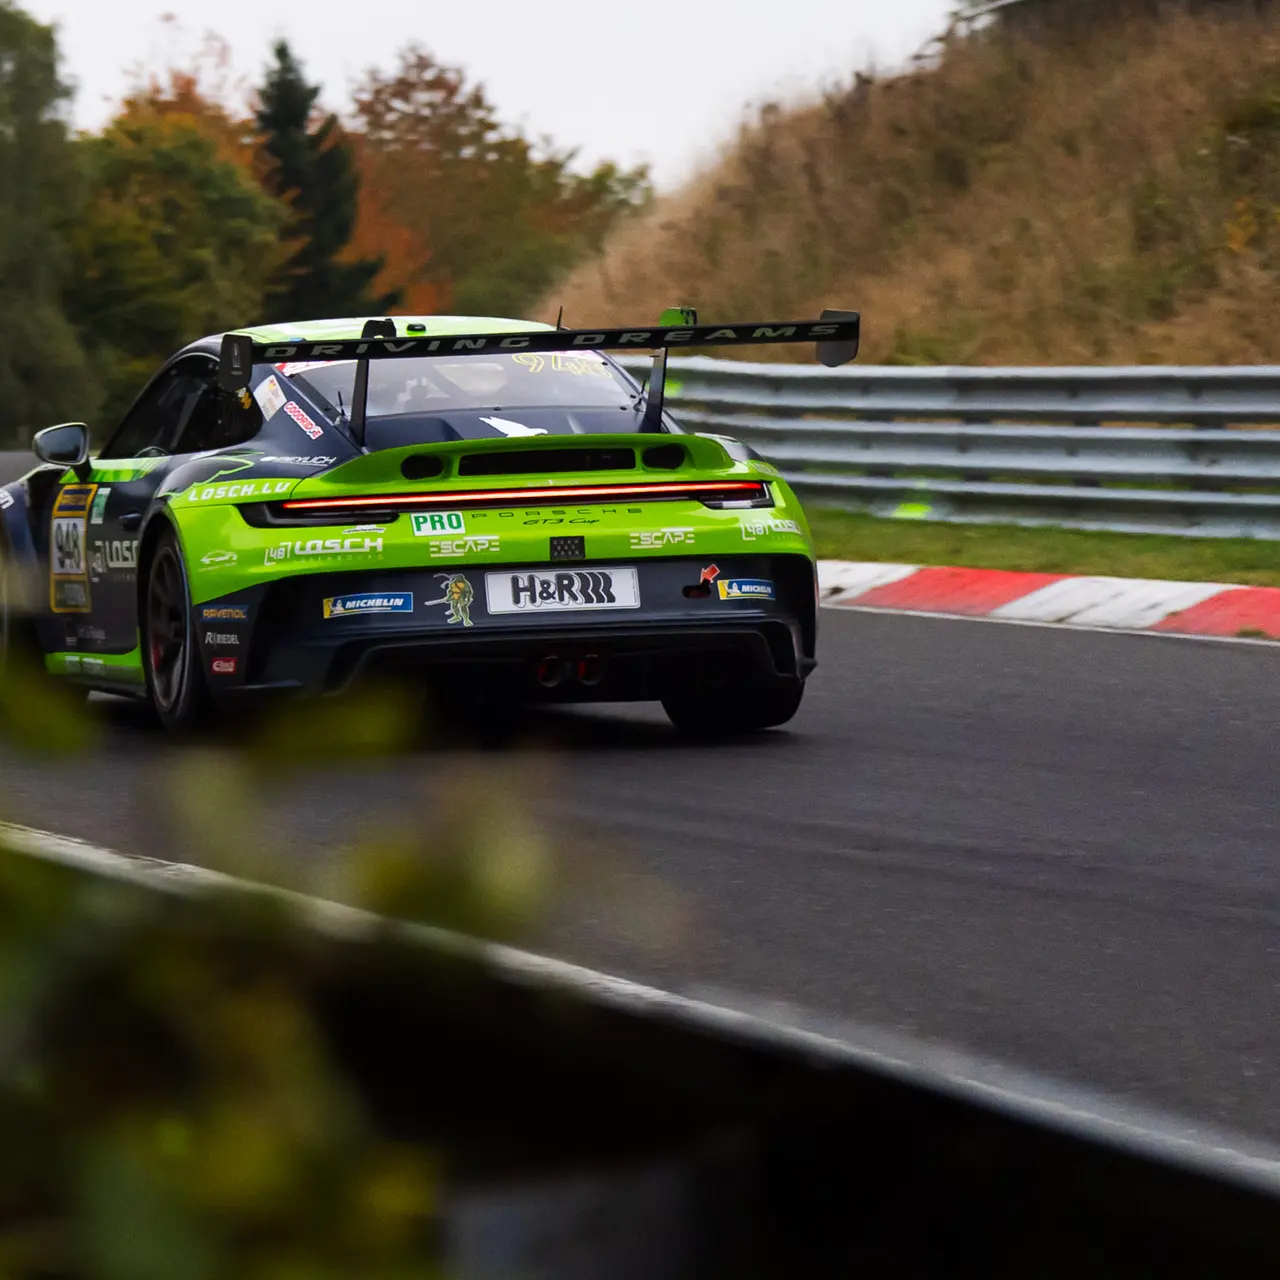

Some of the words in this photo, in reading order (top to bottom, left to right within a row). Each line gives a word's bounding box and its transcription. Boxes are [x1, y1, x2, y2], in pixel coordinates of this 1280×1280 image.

[264, 336, 530, 358] DRIVING
[572, 324, 840, 347] DREAMS
[189, 481, 291, 502] LOSCH.LU
[413, 512, 463, 533] PRO
[472, 508, 642, 519] PORSCHE
[568, 517, 600, 525] Cup
[295, 537, 383, 555] LOSCH
[429, 536, 500, 556] ESCAPE
[630, 528, 695, 549] ESCAPE
[345, 597, 405, 609] MICHELIN
